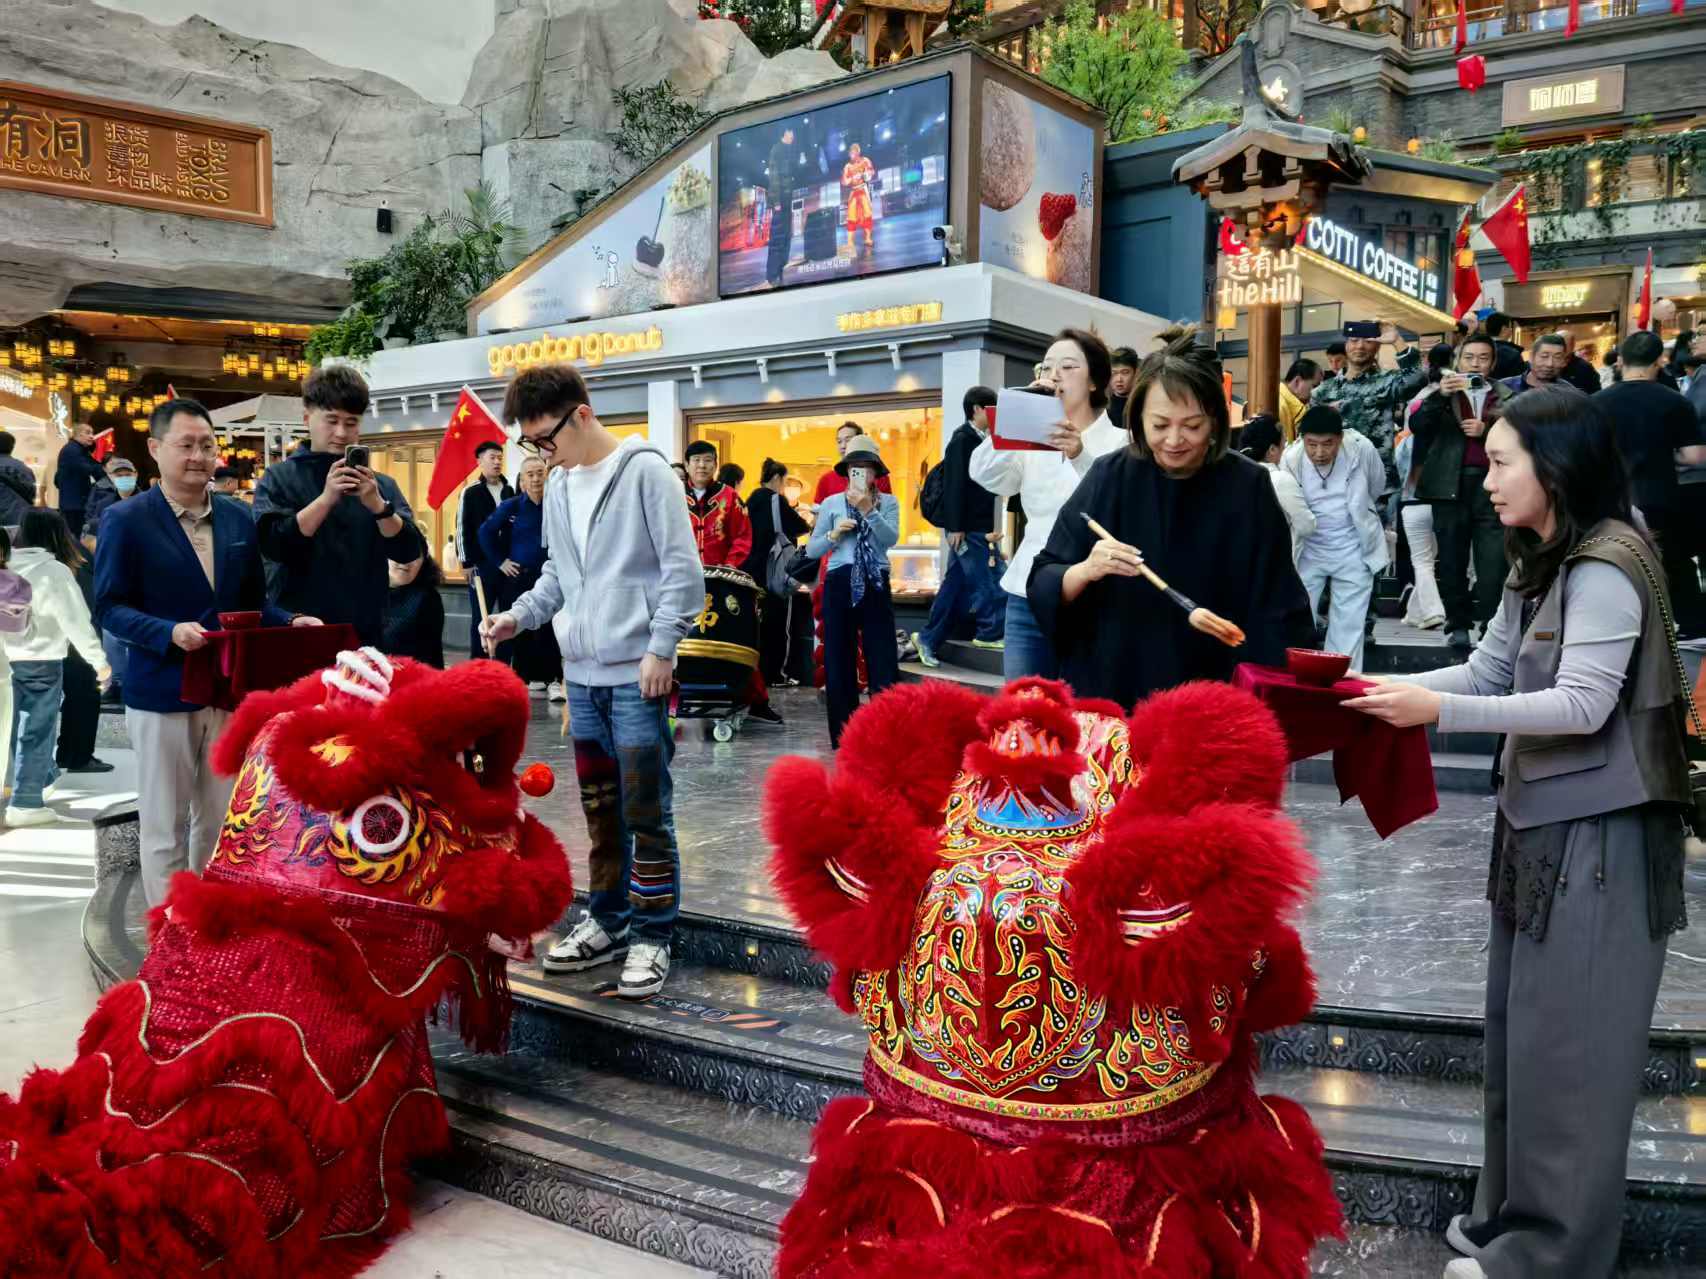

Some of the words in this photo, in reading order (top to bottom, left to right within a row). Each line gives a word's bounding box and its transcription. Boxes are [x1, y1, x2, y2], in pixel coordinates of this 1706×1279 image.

[189, 144, 210, 200] TOXIC
[208, 137, 231, 203] BRAVO
[1309, 216, 1359, 269] COTTI
[1362, 242, 1418, 297] COFFEE
